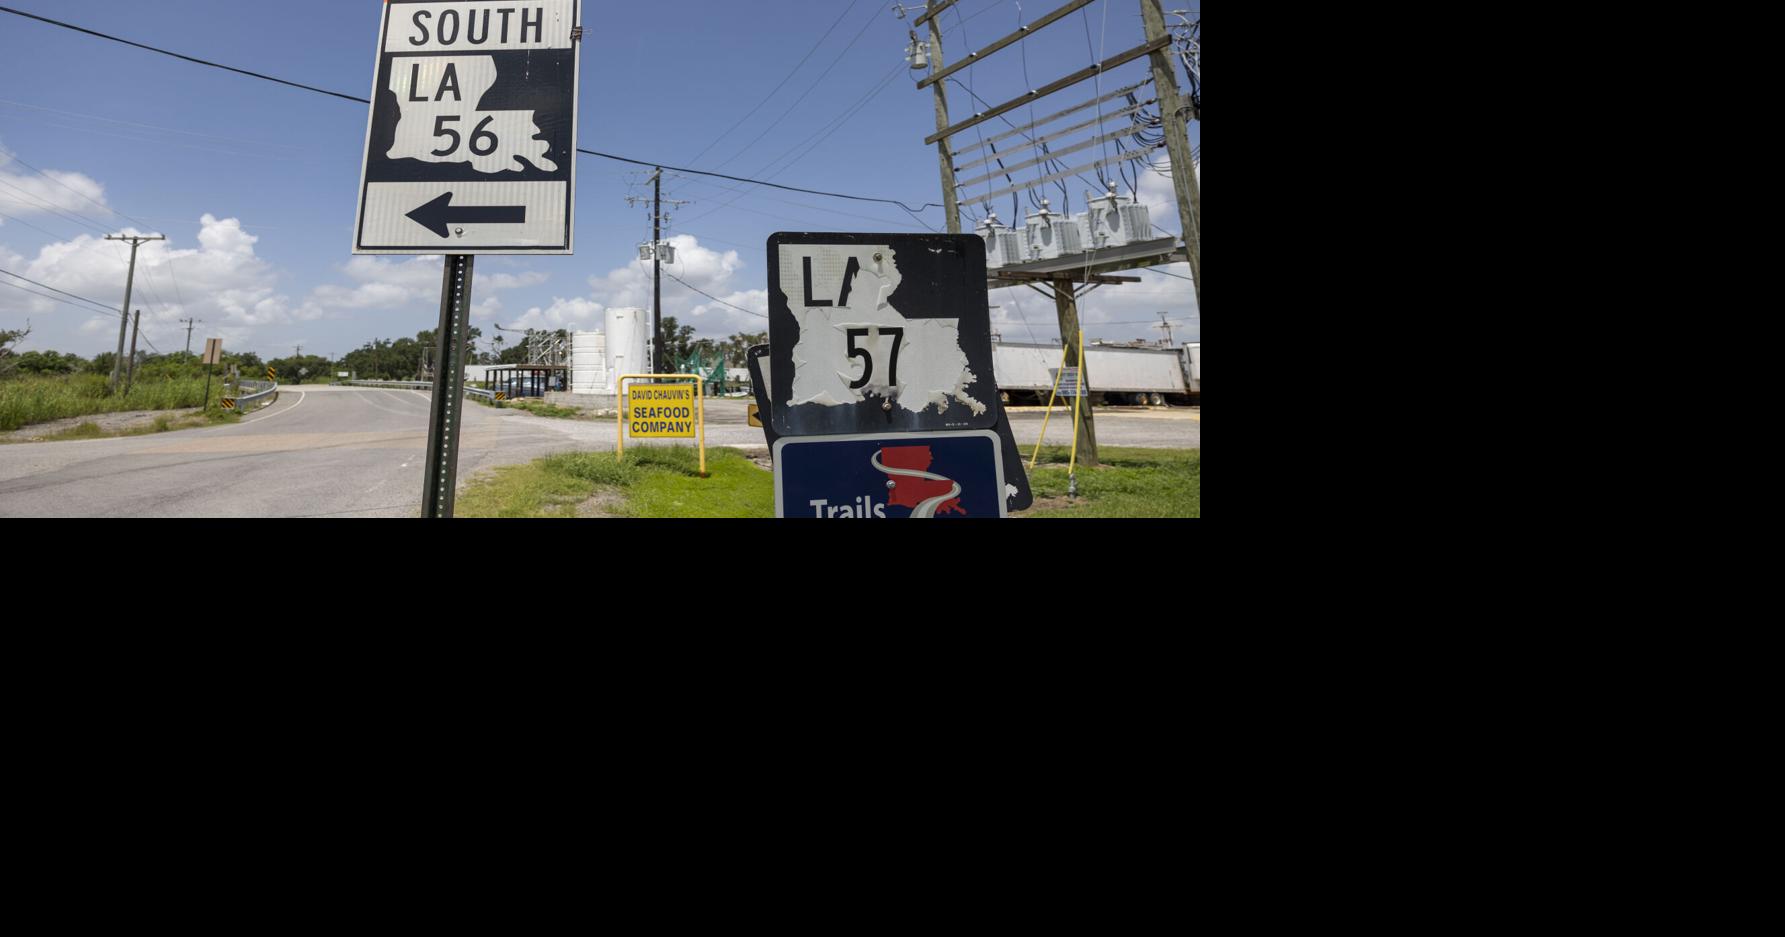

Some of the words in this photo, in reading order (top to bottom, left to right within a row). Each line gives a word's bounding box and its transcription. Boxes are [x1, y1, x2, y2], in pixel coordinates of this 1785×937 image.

[408, 7, 544, 46] SOUTH
[408, 62, 462, 102] LA
[430, 114, 499, 157] 56
[846, 327, 904, 389] 57
[632, 390, 653, 400] DAVID
[653, 389, 690, 400] CHAUVIN'S
[631, 421, 692, 433] COMPANY
[633, 407, 690, 418] SEAFOOD
[809, 495, 887, 518] Trails
